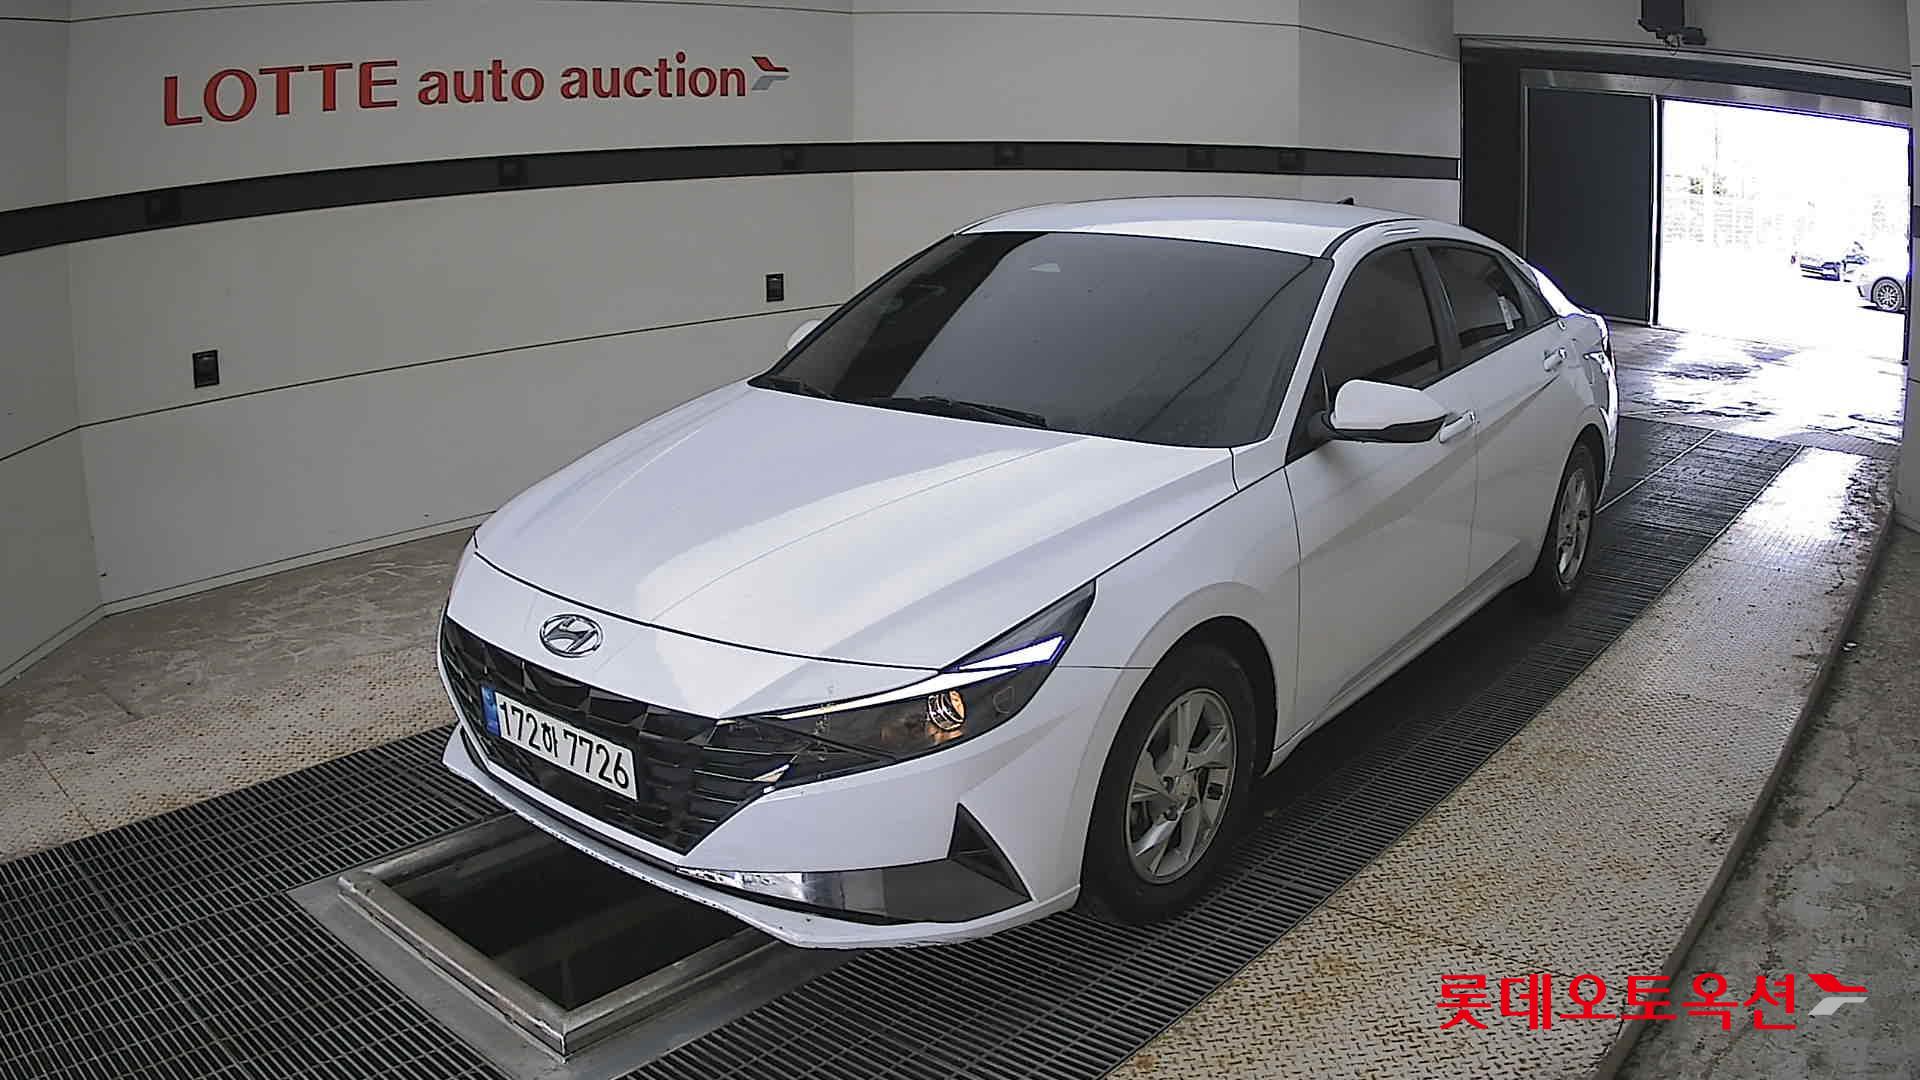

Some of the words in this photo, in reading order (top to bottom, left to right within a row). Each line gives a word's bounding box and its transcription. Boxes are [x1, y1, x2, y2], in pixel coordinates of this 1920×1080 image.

[163, 60, 399, 126] LOTTE
[416, 59, 545, 105] auto
[559, 51, 748, 98] auction
[500, 701, 560, 758] 172하
[563, 728, 629, 789] 7726
